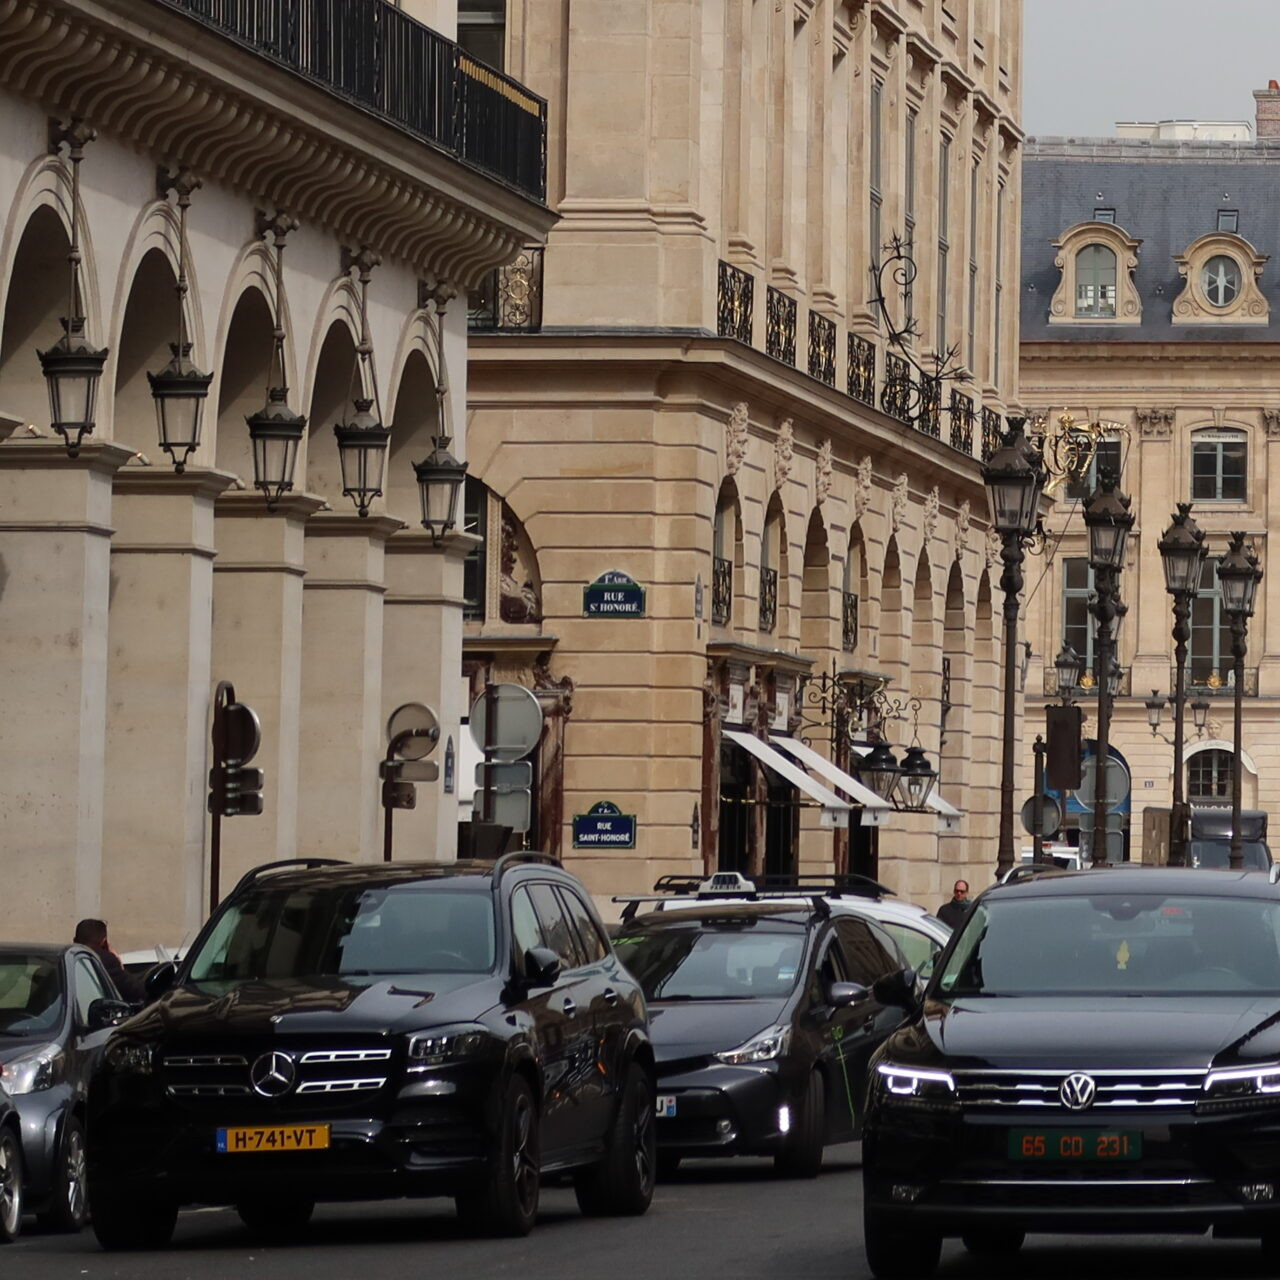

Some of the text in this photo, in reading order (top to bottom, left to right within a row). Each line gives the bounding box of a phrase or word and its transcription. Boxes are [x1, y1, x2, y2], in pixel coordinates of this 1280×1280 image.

[604, 592, 625, 602] RUE
[597, 822, 612, 830] RUE
[579, 832, 630, 842] SAINT-HONORÉ
[235, 1129, 317, 1149] H-741-VT
[1022, 1136, 1129, 1157] 65 CD 231
